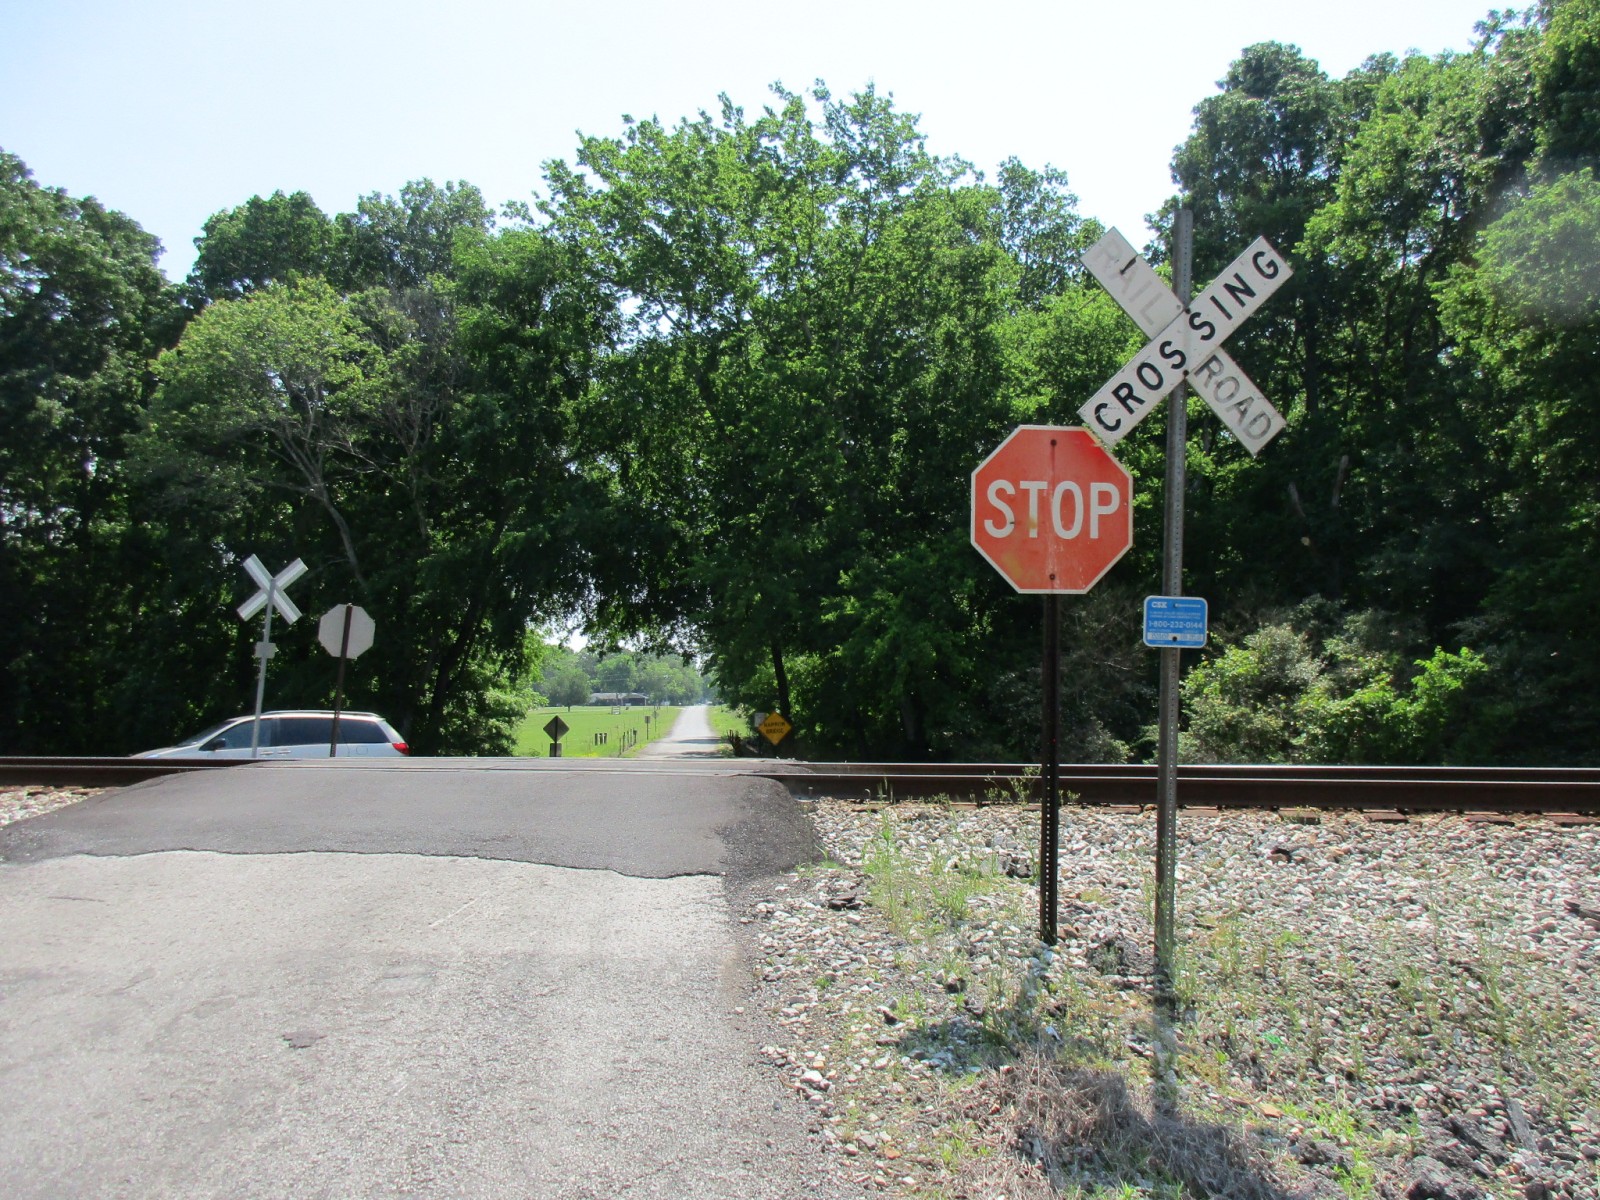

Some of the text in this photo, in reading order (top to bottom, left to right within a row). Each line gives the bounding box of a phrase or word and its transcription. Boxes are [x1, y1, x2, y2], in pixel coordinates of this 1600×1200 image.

[1094, 251, 1279, 432] CROSSING
[1194, 355, 1272, 441] ROAD
[984, 479, 1120, 540] STOP
